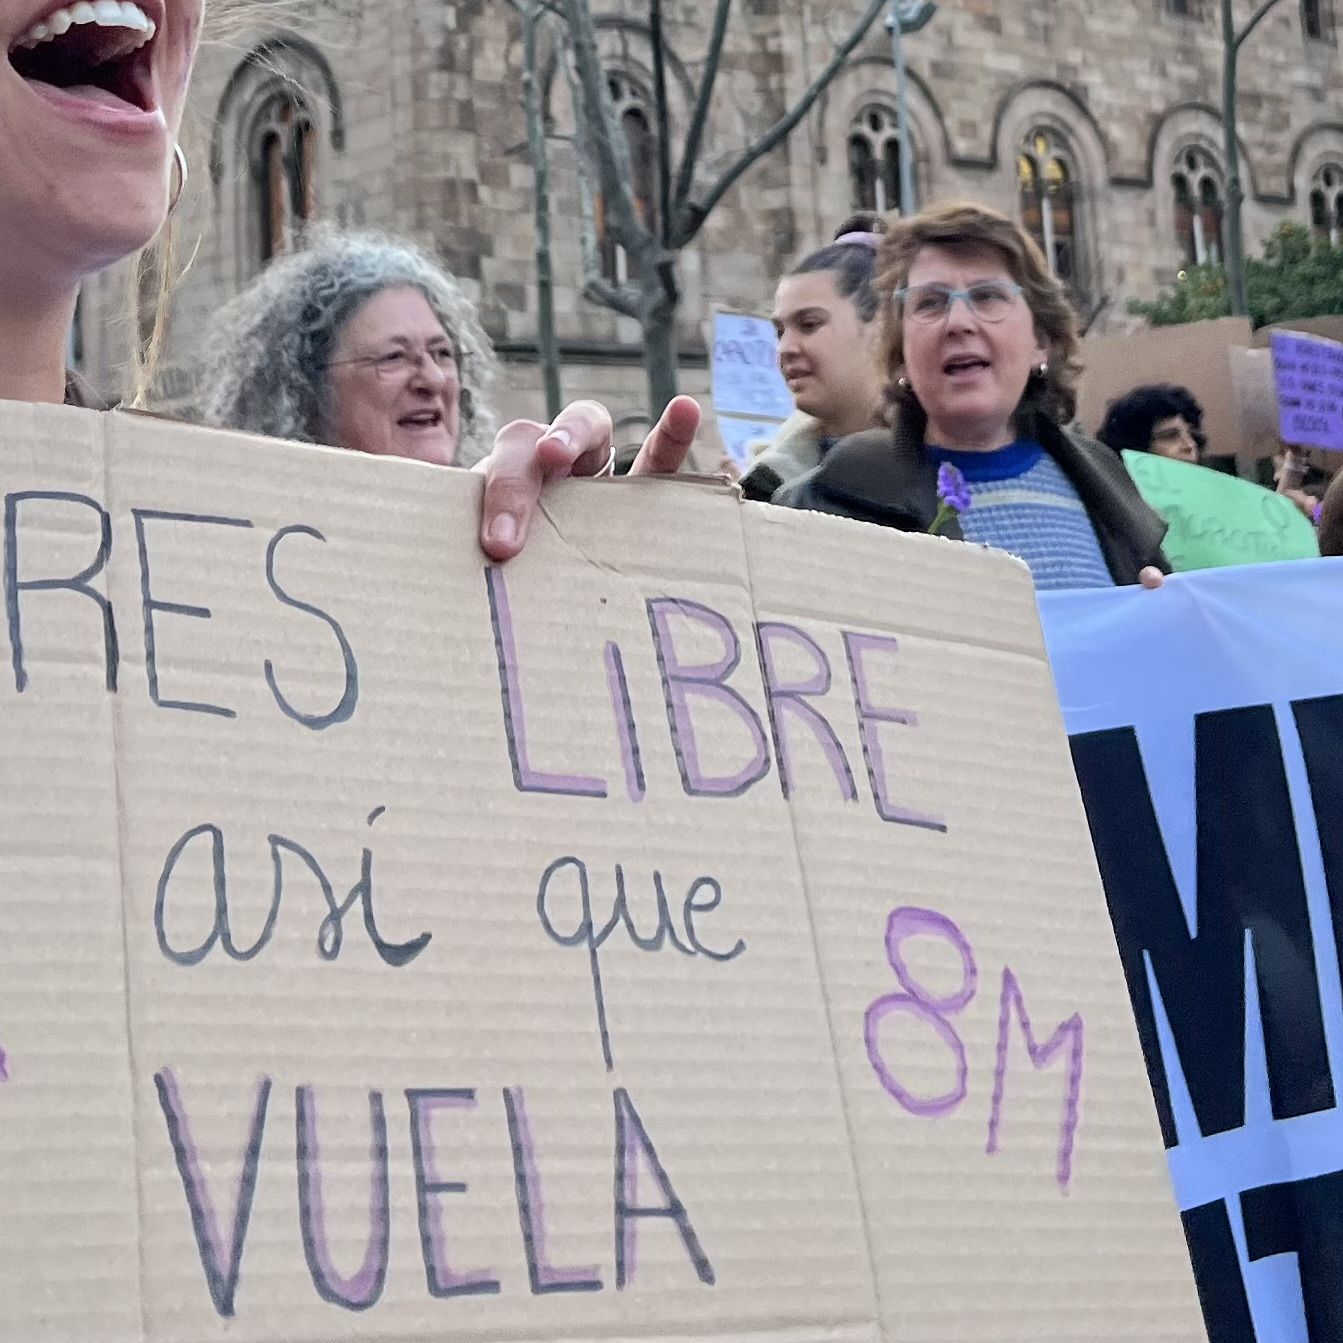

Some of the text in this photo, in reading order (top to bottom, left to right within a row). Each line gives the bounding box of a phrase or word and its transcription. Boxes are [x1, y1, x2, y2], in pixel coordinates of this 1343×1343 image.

[536, 856, 747, 1073] que
[863, 906, 1083, 1196] 8M
[154, 1067, 716, 1319] VUELA
